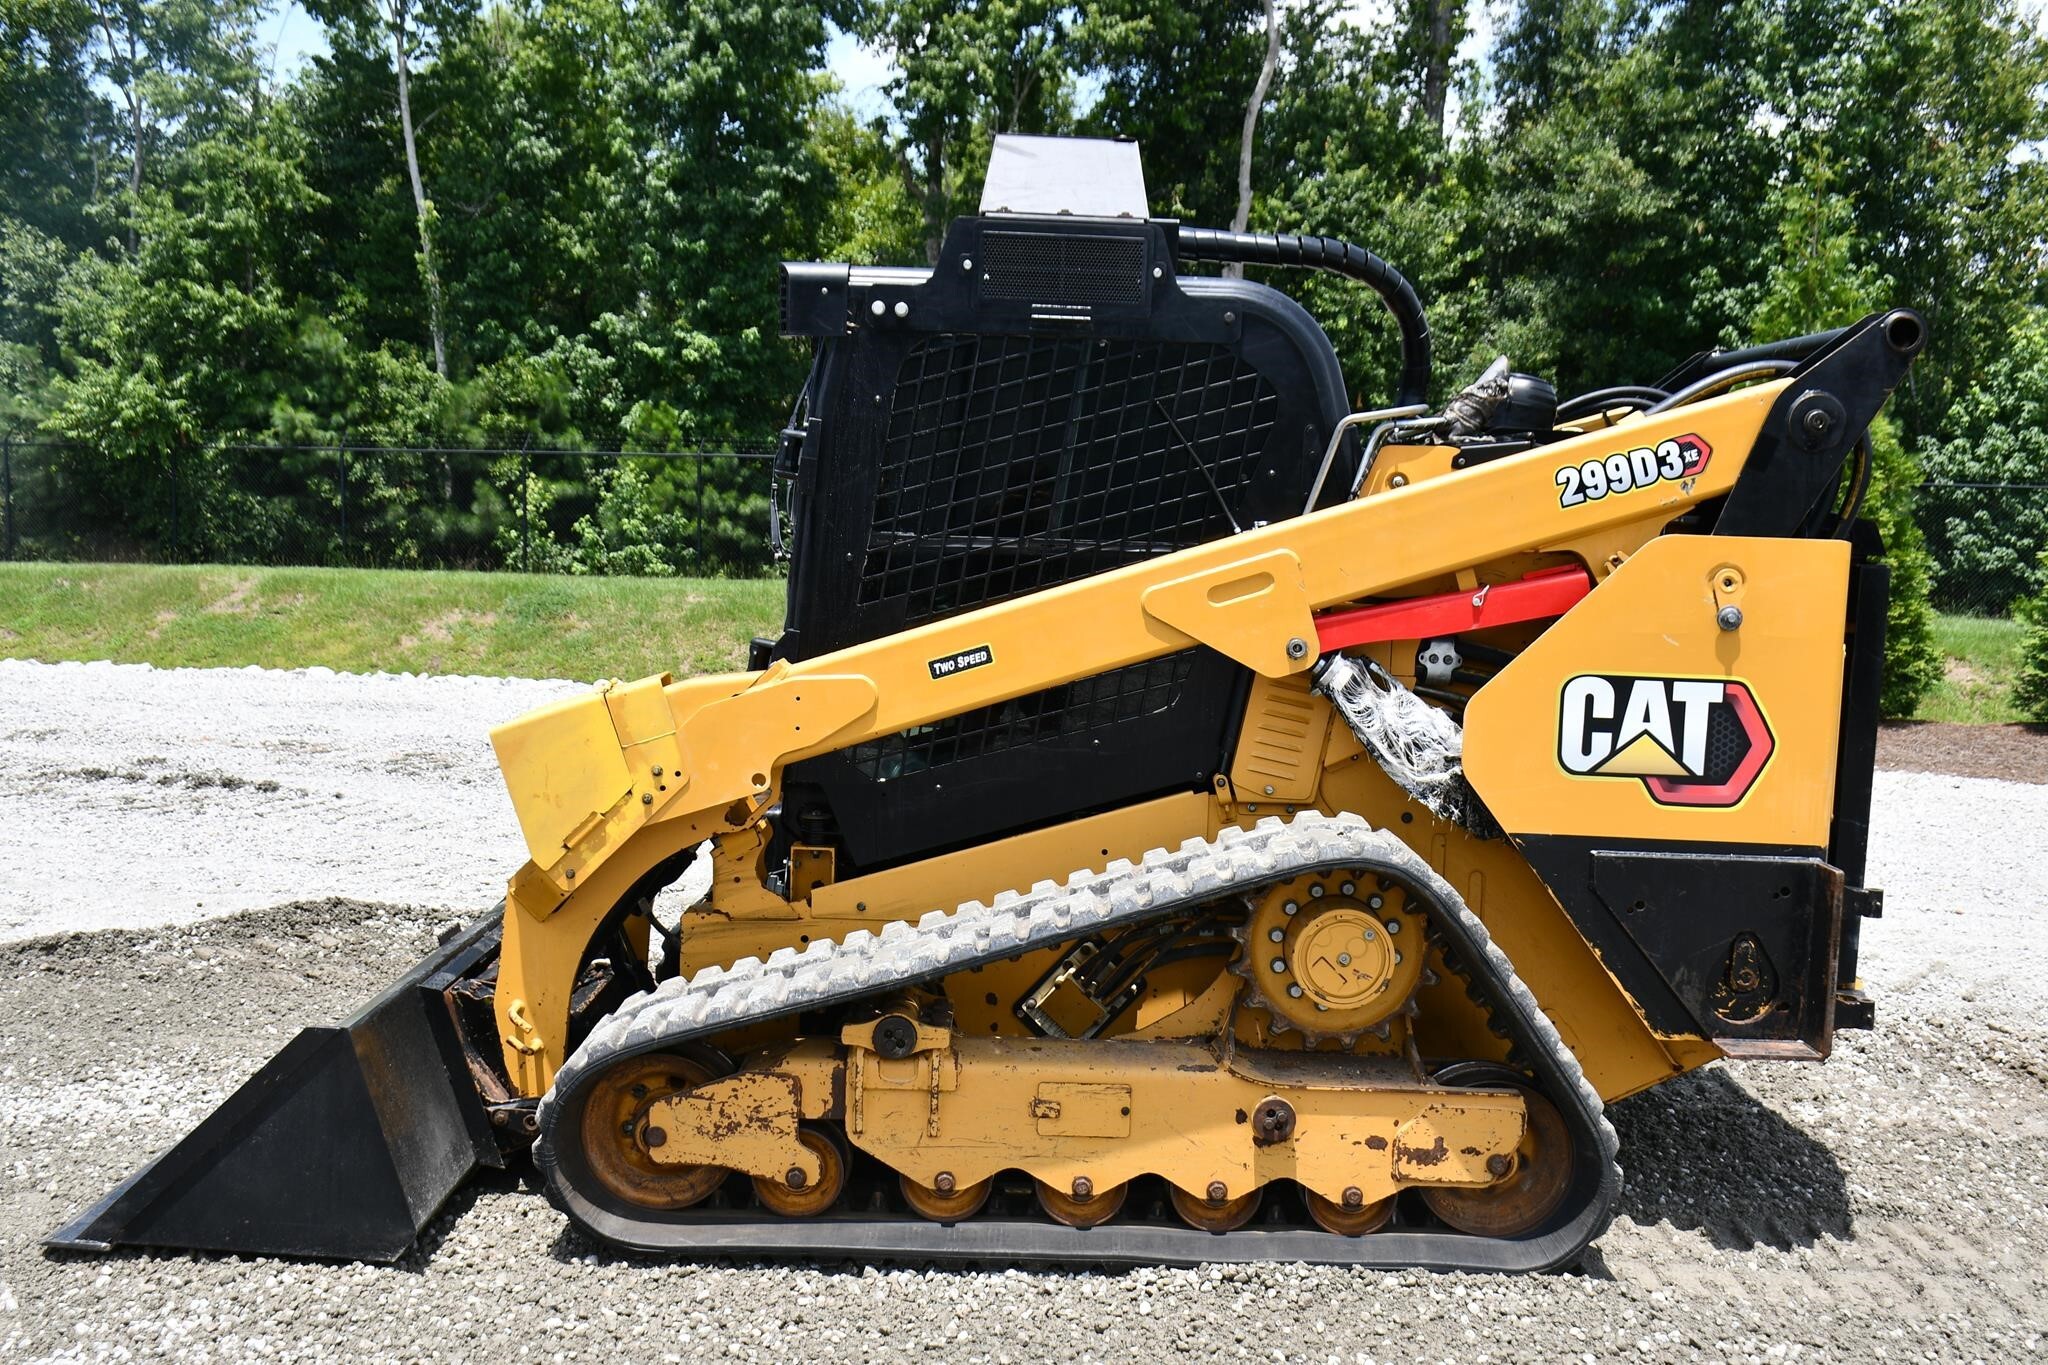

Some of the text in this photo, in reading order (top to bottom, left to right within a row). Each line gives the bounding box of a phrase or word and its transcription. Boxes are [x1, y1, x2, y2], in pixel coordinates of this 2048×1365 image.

[1556, 441, 1700, 507] 299D3 XE
[933, 651, 987, 675] TWO SPEED
[1561, 676, 1724, 777] CAT
